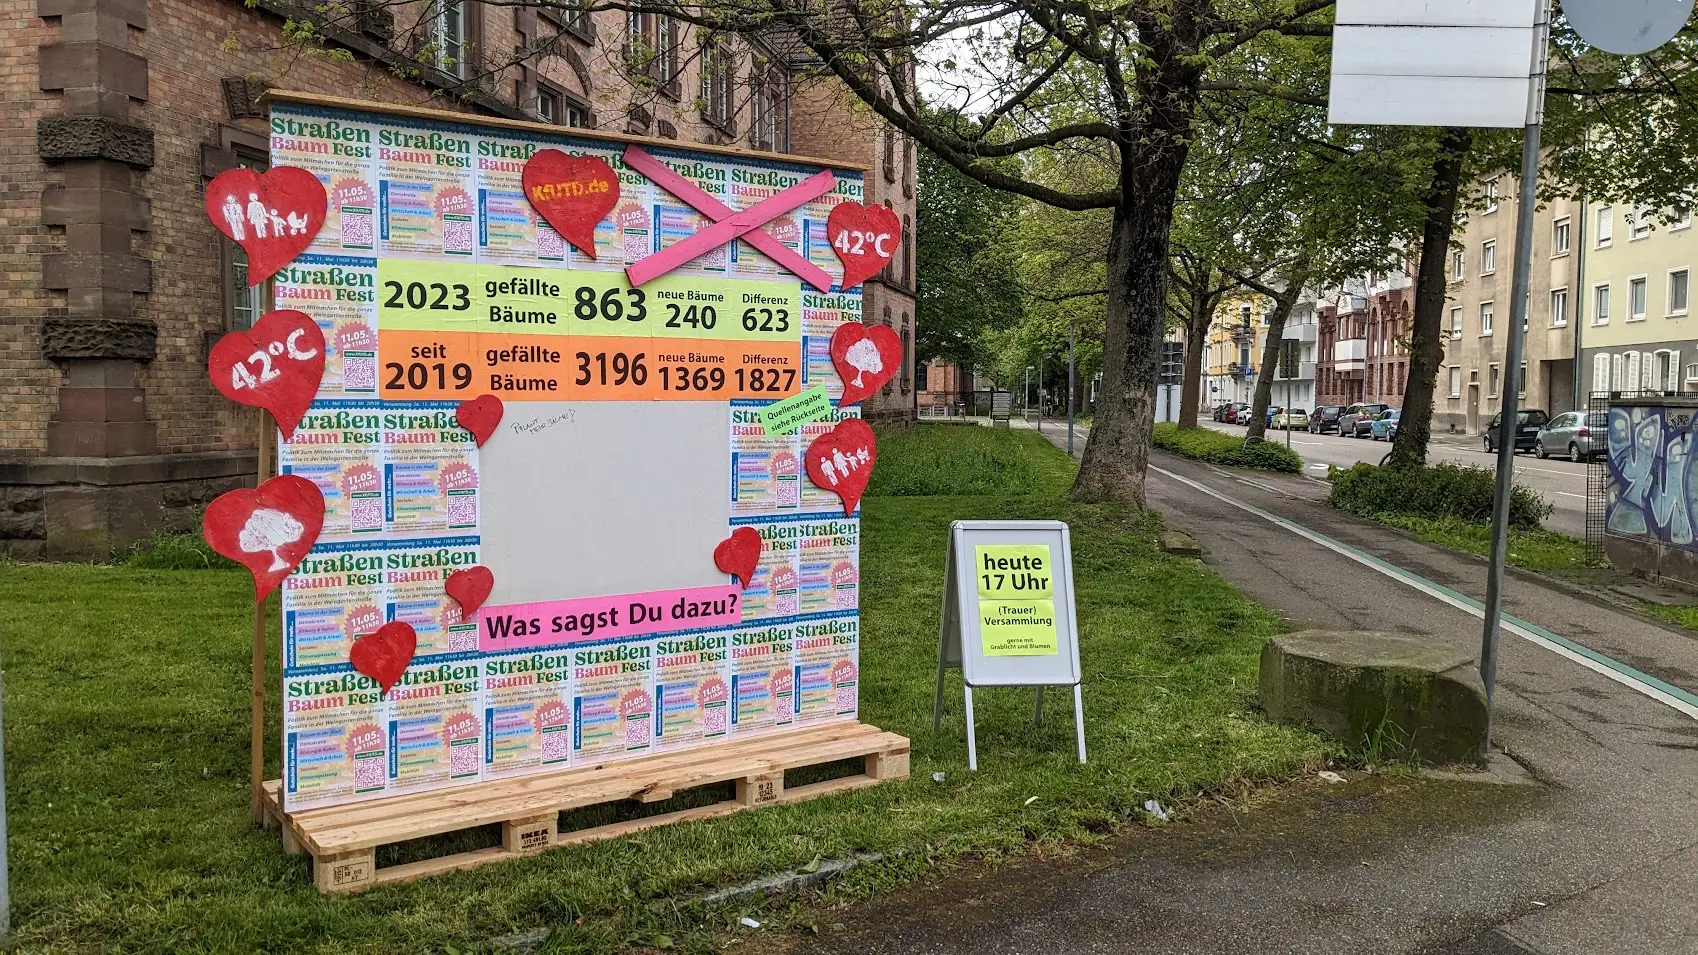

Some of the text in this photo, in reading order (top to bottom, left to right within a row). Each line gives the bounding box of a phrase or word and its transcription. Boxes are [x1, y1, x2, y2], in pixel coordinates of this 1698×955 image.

[270, 117, 372, 144] Straßen
[271, 136, 372, 158] Baum Fest
[378, 129, 471, 154] Straßen
[477, 140, 536, 159] Straß
[378, 147, 471, 168] Baum Fest
[338, 186, 367, 198] 11.05.
[441, 195, 467, 206] 11.05.
[621, 210, 644, 221] 11.05.
[835, 229, 891, 258] 42°C
[275, 267, 374, 287] Straßen
[275, 285, 375, 302] Baum Fest
[384, 281, 470, 310] 2023
[485, 278, 560, 298] gefällte
[657, 290, 724, 302] neue Bäume
[574, 286, 648, 321] 863
[742, 293, 789, 305] Differenz
[490, 306, 556, 324] Bäume
[665, 303, 717, 330] 240
[742, 307, 790, 332] 623
[803, 309, 862, 322] Baum Fes
[341, 330, 369, 343] 11.05.
[232, 328, 318, 390] 42°C
[412, 343, 446, 358] seit
[486, 346, 561, 367] gefällte
[658, 353, 725, 363] neue Bäume
[742, 354, 789, 365] Differenz
[386, 363, 471, 389] 2019
[575, 352, 648, 386] 3196
[491, 375, 557, 390] Bäume
[658, 366, 726, 391] 1369
[734, 368, 797, 392] 1827
[767, 392, 822, 420] Quellenangabe
[298, 411, 381, 429] traßen
[384, 411, 457, 429] Straße
[771, 418, 791, 432] siehe
[791, 404, 825, 424] Rückseite
[342, 432, 381, 444] Fest
[384, 431, 476, 445] Baum Fest
[347, 472, 376, 485] 11.05.
[445, 472, 471, 483] 11.05.
[772, 541, 797, 551] Fest
[833, 536, 857, 546] Fest
[387, 548, 477, 569] Straßen
[984, 553, 1043, 570] heute
[286, 571, 383, 591] Baum Fest
[386, 568, 438, 584] Baum
[982, 573, 1049, 591] 17 Uhr
[351, 611, 379, 627] 11.05.
[486, 594, 737, 638] Was sagst Du dazu?
[998, 605, 1037, 616] (Trauer)
[795, 620, 856, 637] Straßen
[984, 616, 1052, 627] Versammlung
[656, 635, 727, 655] Straßen
[795, 633, 856, 650] Baum Fest
[574, 644, 651, 666] Straßen
[656, 650, 727, 668] Baum Fest
[732, 643, 792, 659] Baum Fes
[485, 654, 568, 676] Straßen
[574, 661, 651, 679] Baum Fest
[485, 670, 569, 690] Baum Fest
[389, 681, 479, 701] Baum Fest
[703, 684, 723, 695] 11.05.
[288, 691, 385, 712] Baum Fest
[624, 696, 646, 709] 11.05.
[539, 709, 564, 721] 11.05.
[448, 719, 474, 733] 11.05.
[352, 733, 380, 746] 11.05.
[521, 828, 549, 839] IKEA
